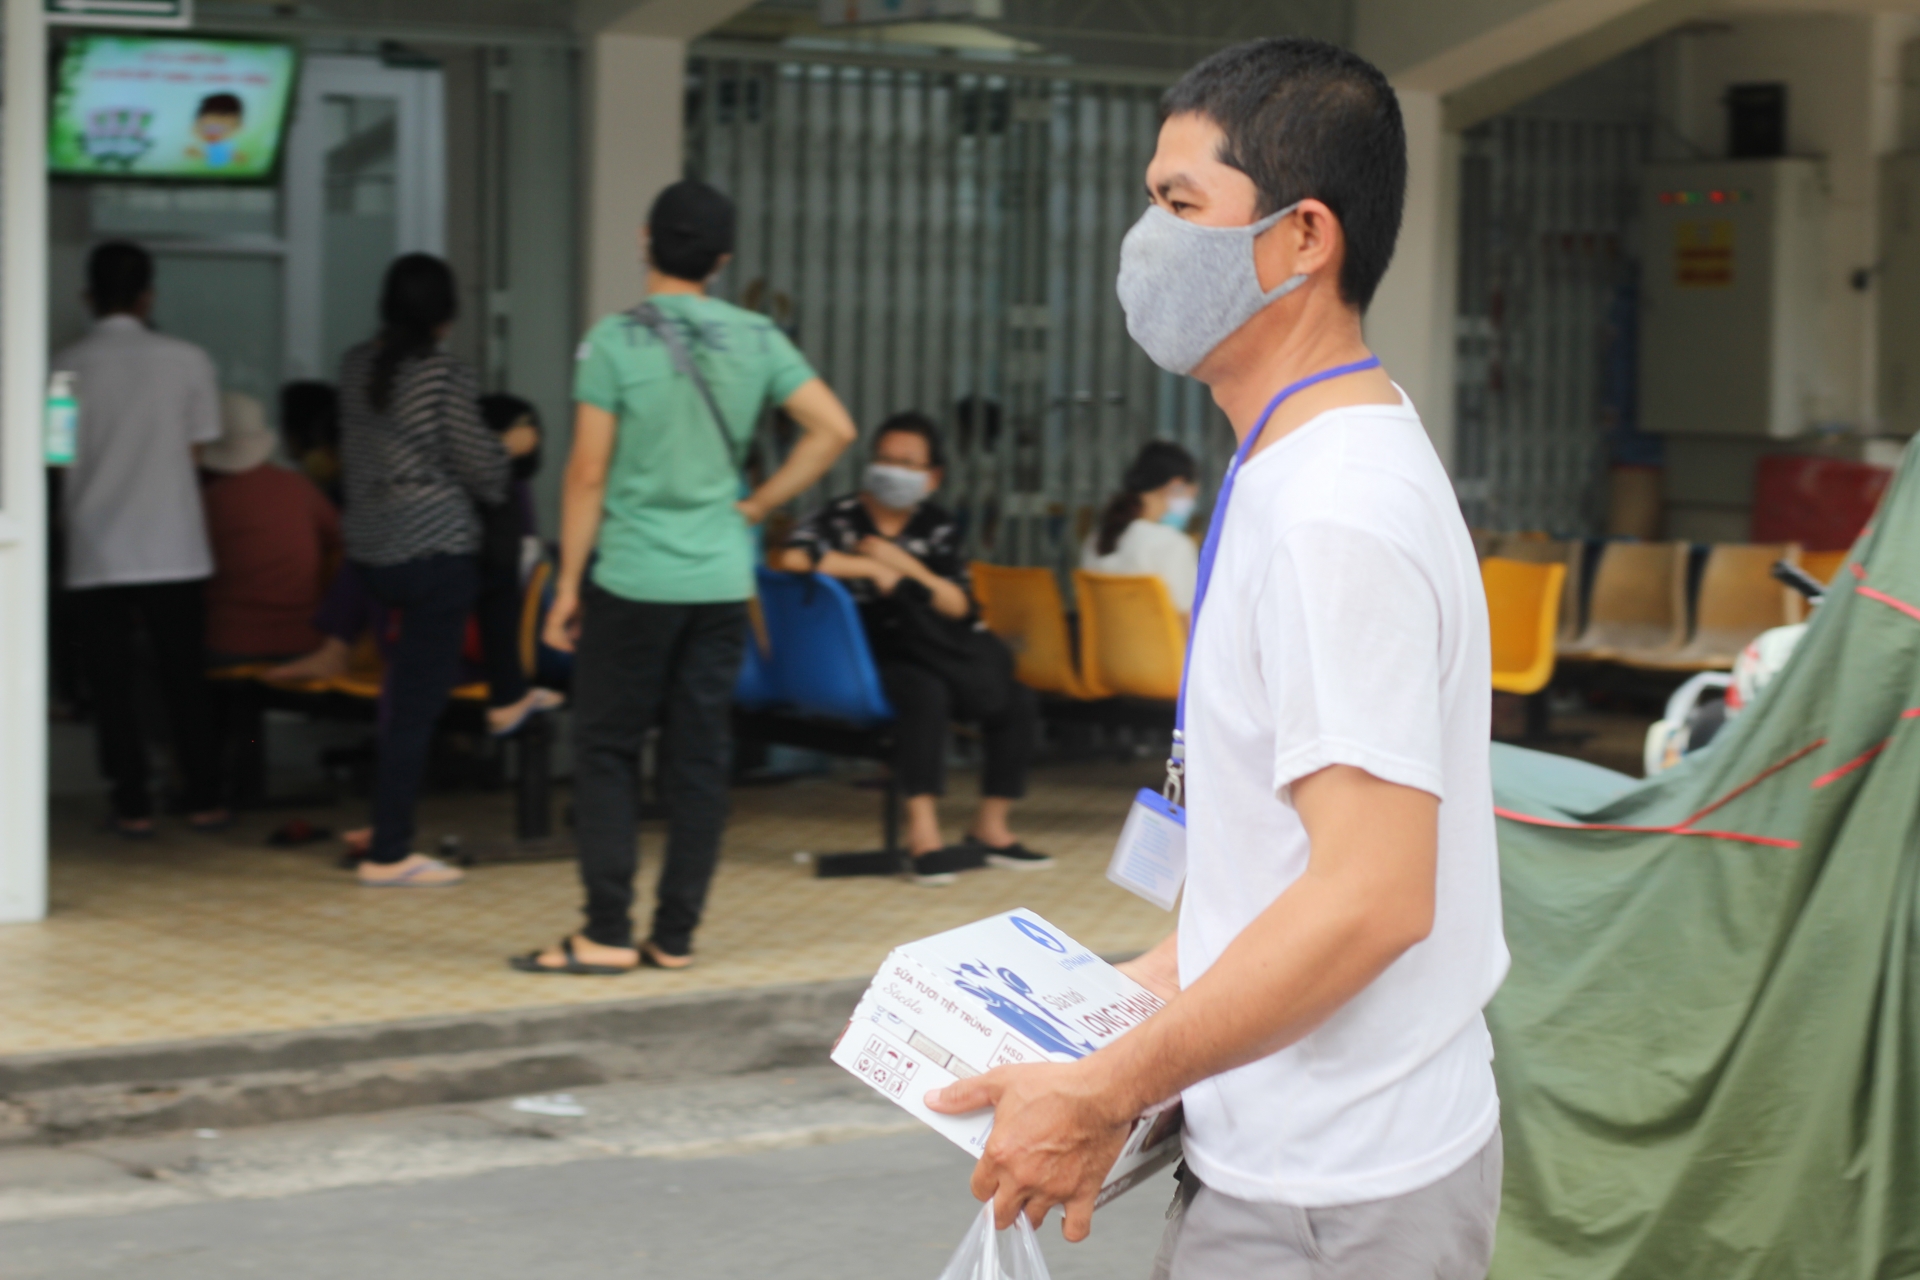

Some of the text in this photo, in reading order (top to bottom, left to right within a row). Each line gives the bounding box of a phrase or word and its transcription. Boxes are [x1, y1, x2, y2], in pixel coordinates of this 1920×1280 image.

[940, 997, 959, 1014] TIỆT
[959, 1011, 993, 1037] TRÙNG
[1074, 990, 1168, 1038] LONG THÀNH
